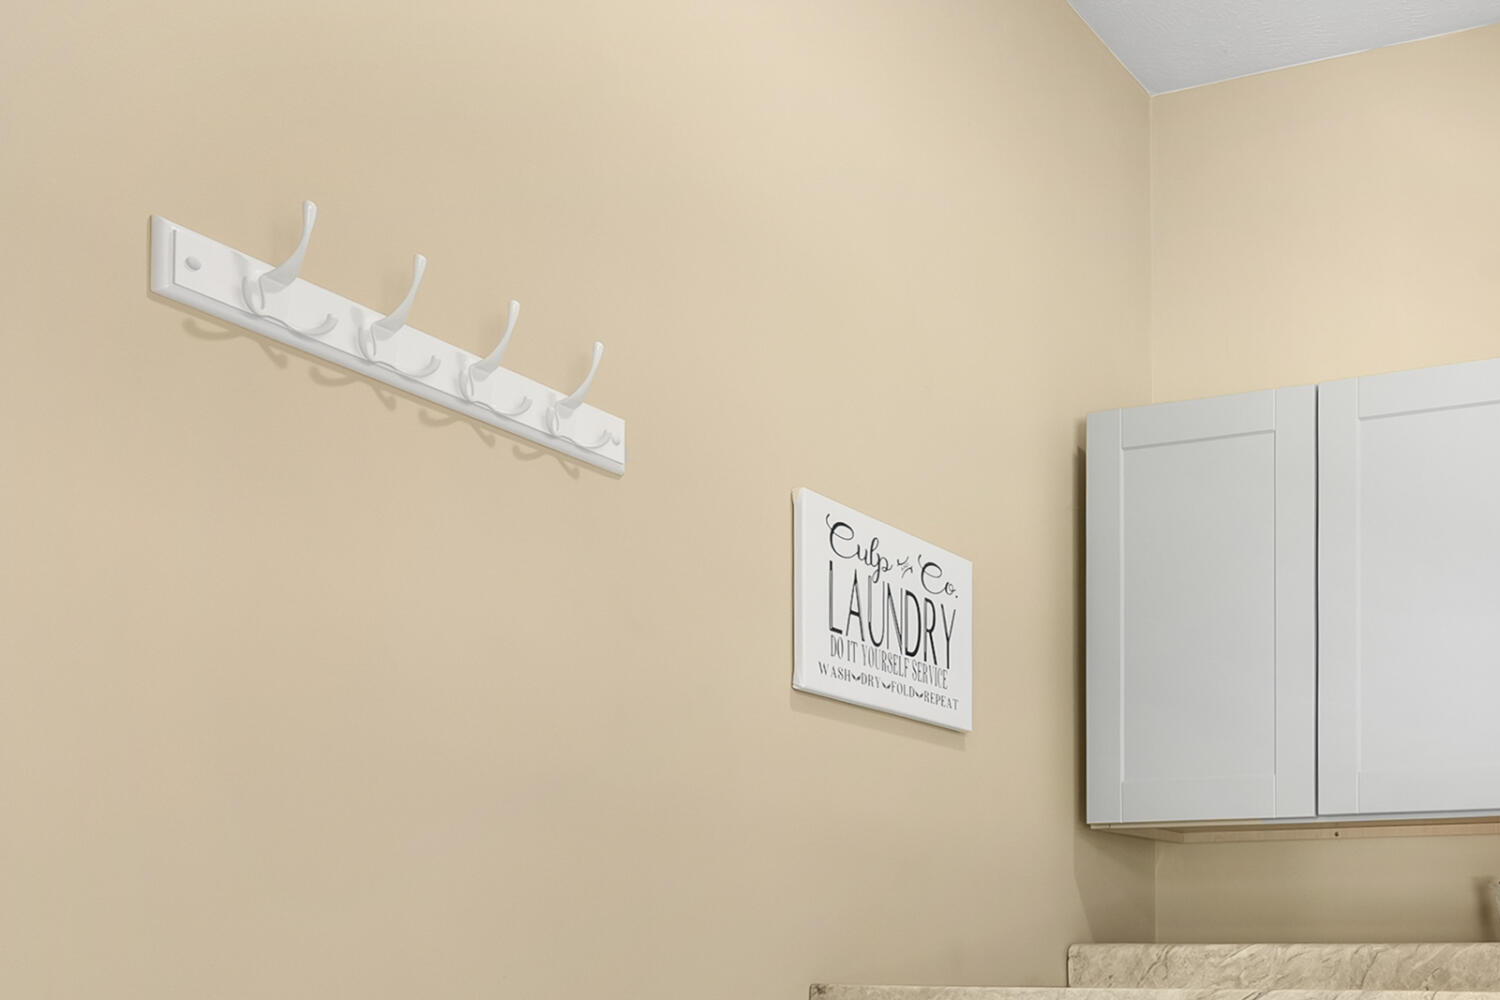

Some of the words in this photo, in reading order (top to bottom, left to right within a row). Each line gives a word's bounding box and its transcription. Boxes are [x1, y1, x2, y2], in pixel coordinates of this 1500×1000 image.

[825, 513, 893, 584] Culp
[917, 553, 959, 599] Co.
[828, 560, 957, 670] LAUNDRY
[818, 661, 852, 683] WASH
[860, 671, 881, 690] DRY
[891, 680, 915, 699] FOLD
[923, 690, 960, 711] REPEAT
[830, 634, 845, 660] DO
[847, 640, 859, 664] IT
[861, 644, 911, 679] YOURSELF
[911, 658, 950, 691] SERVICE
